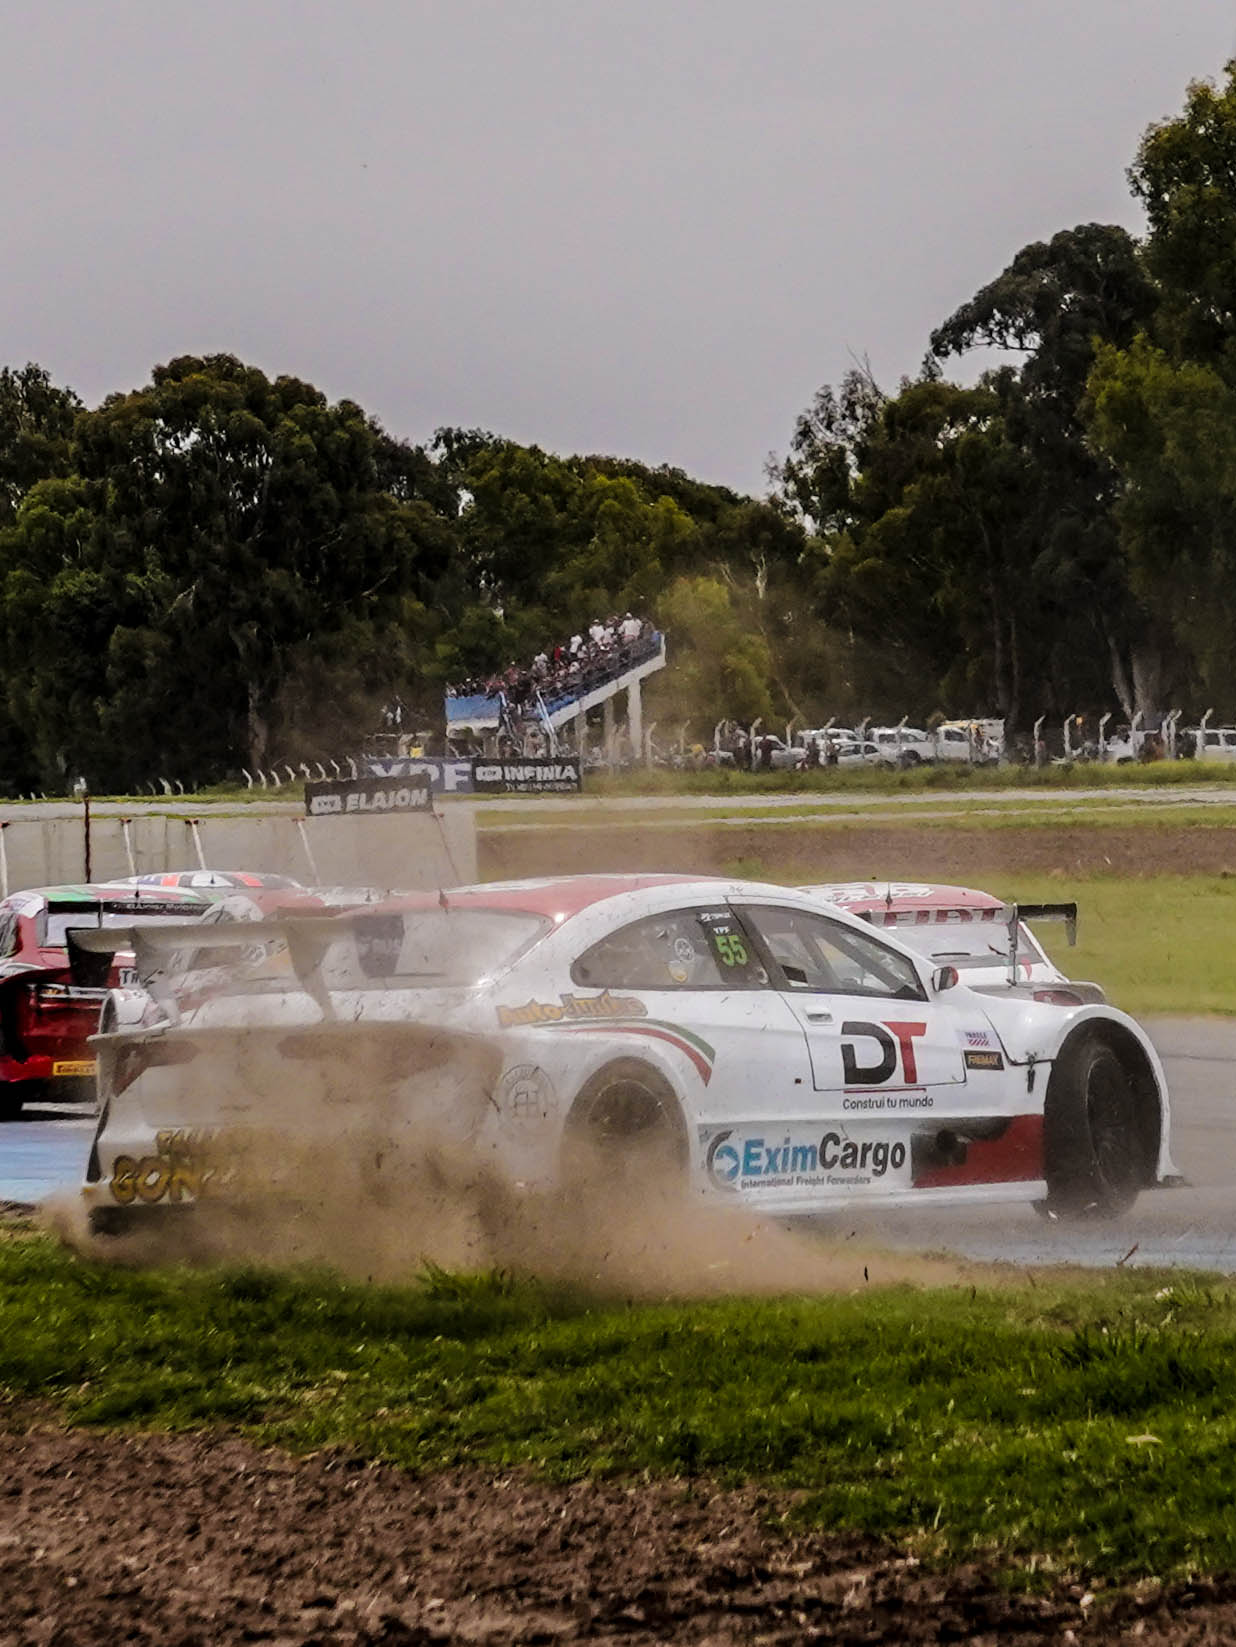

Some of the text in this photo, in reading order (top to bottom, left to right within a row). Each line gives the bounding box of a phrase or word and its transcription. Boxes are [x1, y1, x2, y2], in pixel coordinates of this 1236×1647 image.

[504, 765, 578, 782] INFINIA
[346, 788, 429, 812] ELAION
[714, 934, 748, 968] 55
[841, 1021, 927, 1085] DT
[887, 1097, 897, 1109] tu
[898, 1095, 934, 1109] mundo
[740, 1131, 906, 1178] EximCargo
[740, 1175, 871, 1190] International Freight Forwarders
